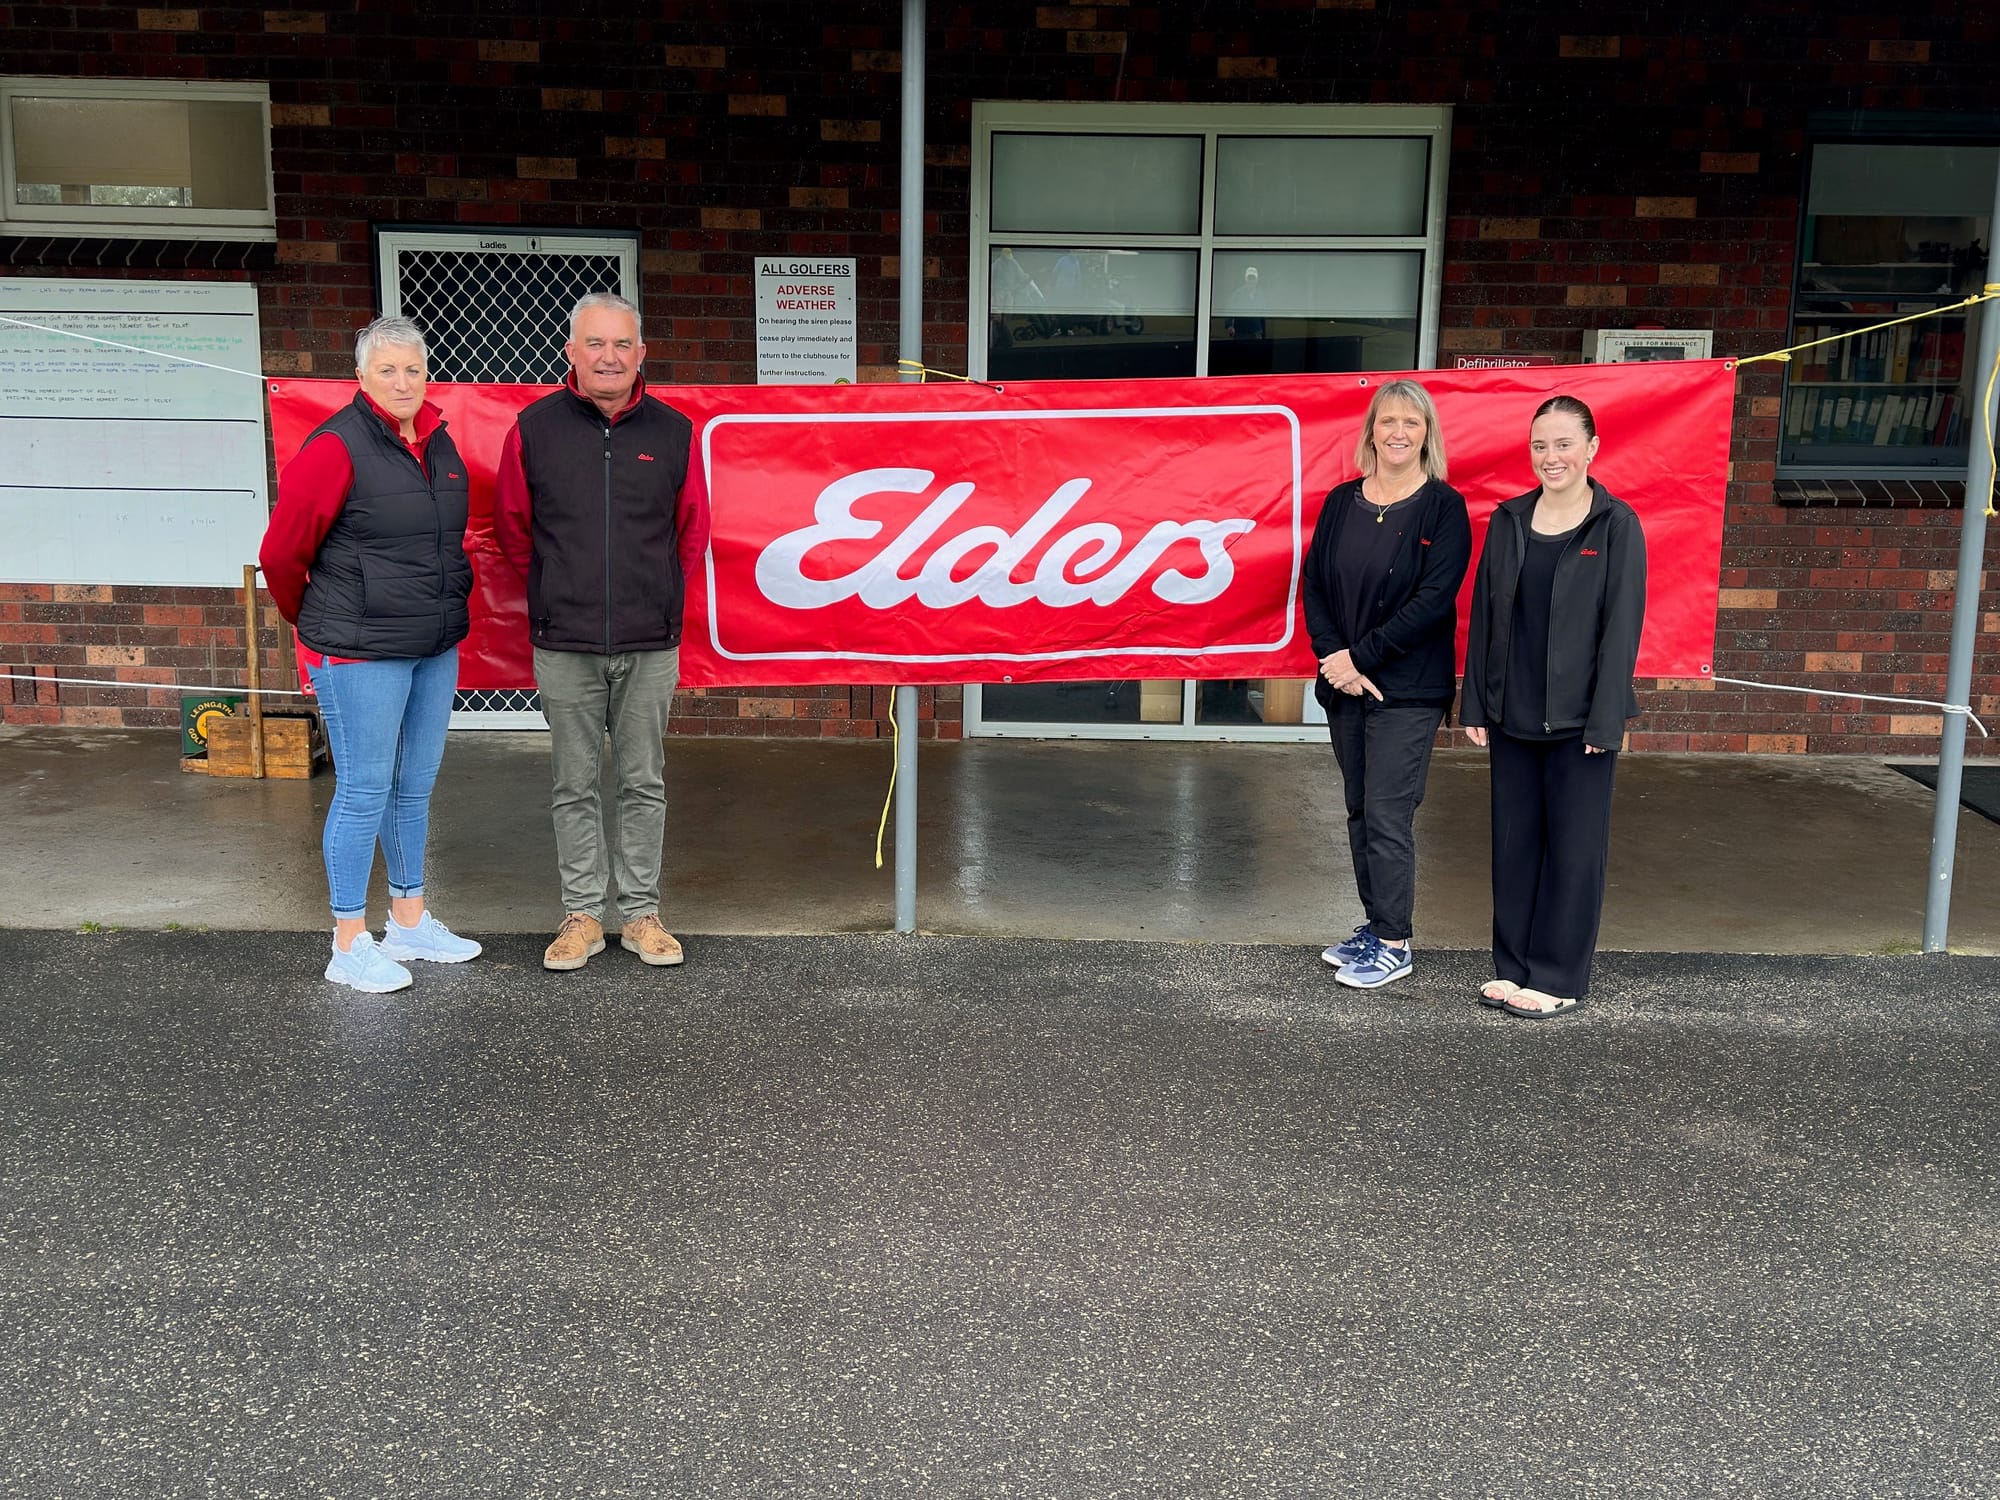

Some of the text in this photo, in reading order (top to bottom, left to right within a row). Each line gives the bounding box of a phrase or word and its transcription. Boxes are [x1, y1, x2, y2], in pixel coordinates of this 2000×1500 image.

[480, 241, 507, 249] Ladies
[761, 264, 850, 275] ALL GOLFERS
[777, 285, 835, 296] ADVERSE
[776, 300, 836, 310] WEATHER
[770, 318, 797, 326] hearing
[829, 318, 852, 327] please
[781, 335, 795, 343] play
[797, 335, 838, 343] immediately
[1457, 357, 1530, 369] Defibrillator
[755, 467, 1257, 609] Elders
[188, 728, 204, 745] GOLF
